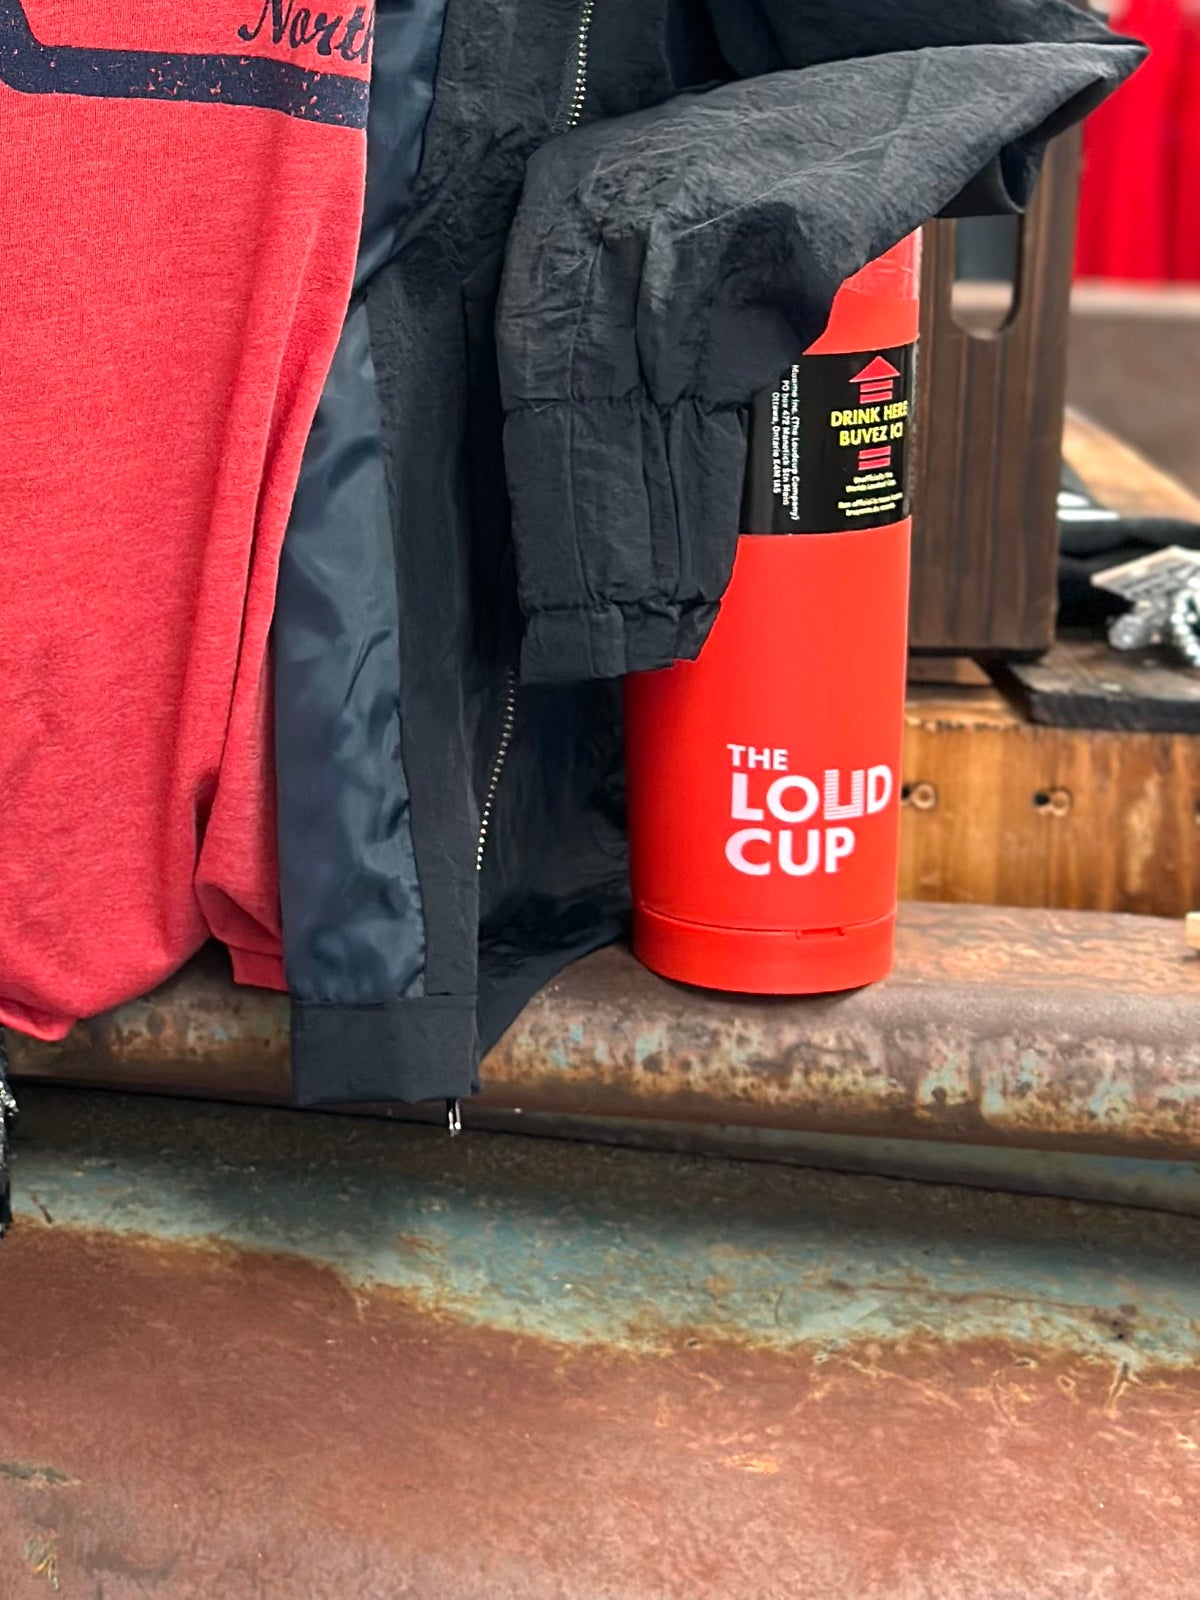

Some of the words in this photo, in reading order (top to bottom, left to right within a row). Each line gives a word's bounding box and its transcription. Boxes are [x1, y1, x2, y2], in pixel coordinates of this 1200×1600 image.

[831, 406, 880, 427] DRINK
[839, 425, 888, 446] BUVEZ
[727, 743, 788, 771] THE
[731, 764, 892, 823] LOUD
[725, 827, 855, 876] CUP
